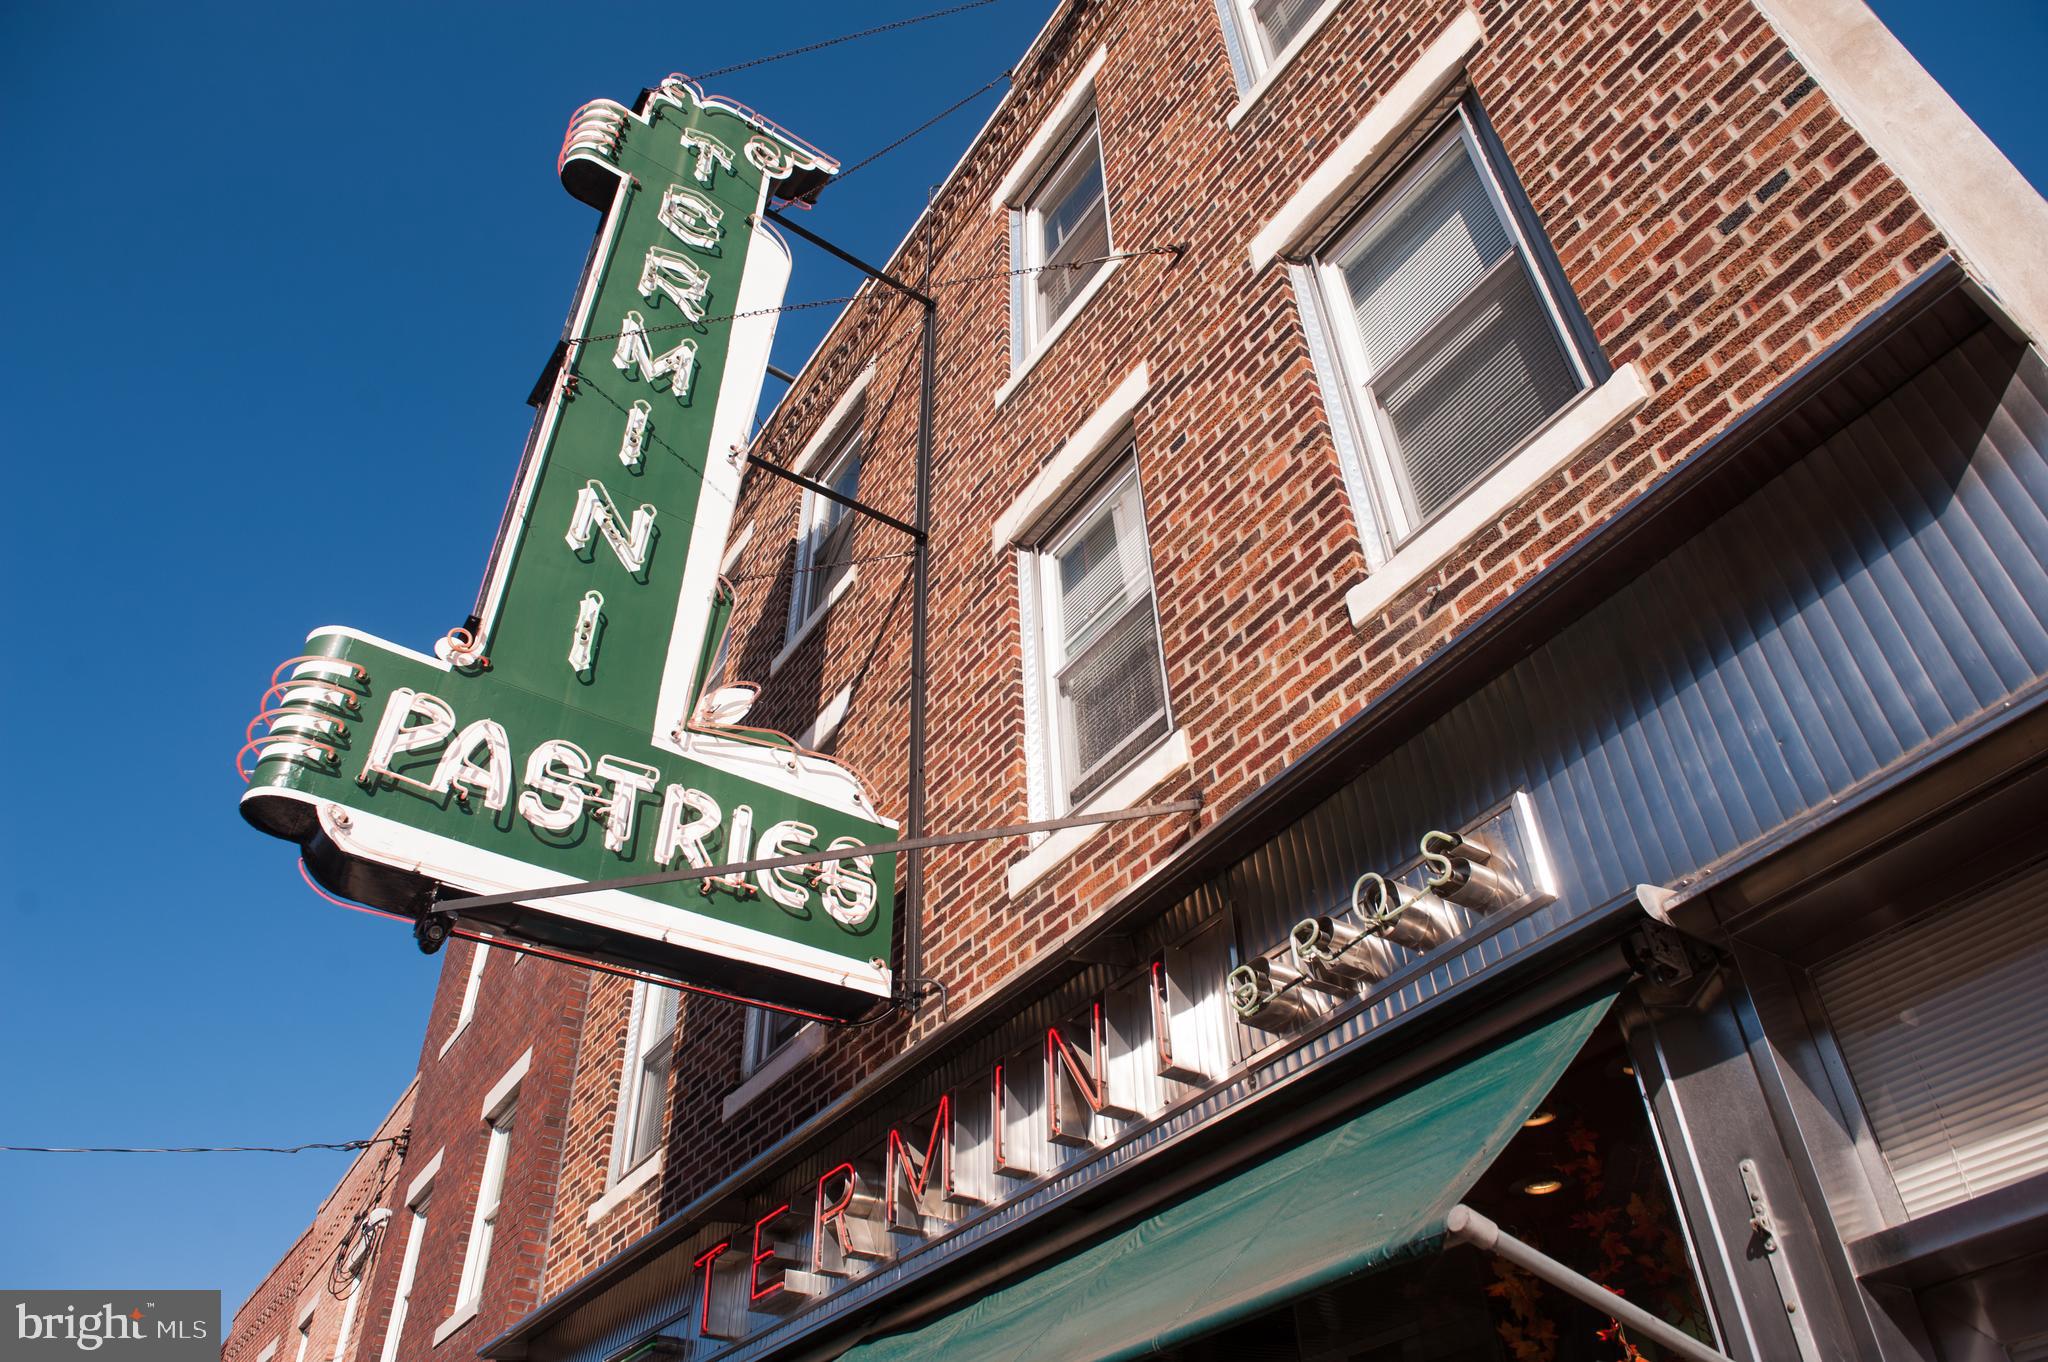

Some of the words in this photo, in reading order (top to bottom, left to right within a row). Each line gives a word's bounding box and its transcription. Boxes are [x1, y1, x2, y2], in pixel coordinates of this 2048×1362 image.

[565, 126, 736, 672] TERMINI
[360, 687, 878, 925] PASTRIES
[692, 950, 1190, 1338] TERMINI
[1227, 829, 1475, 1025] BROS
